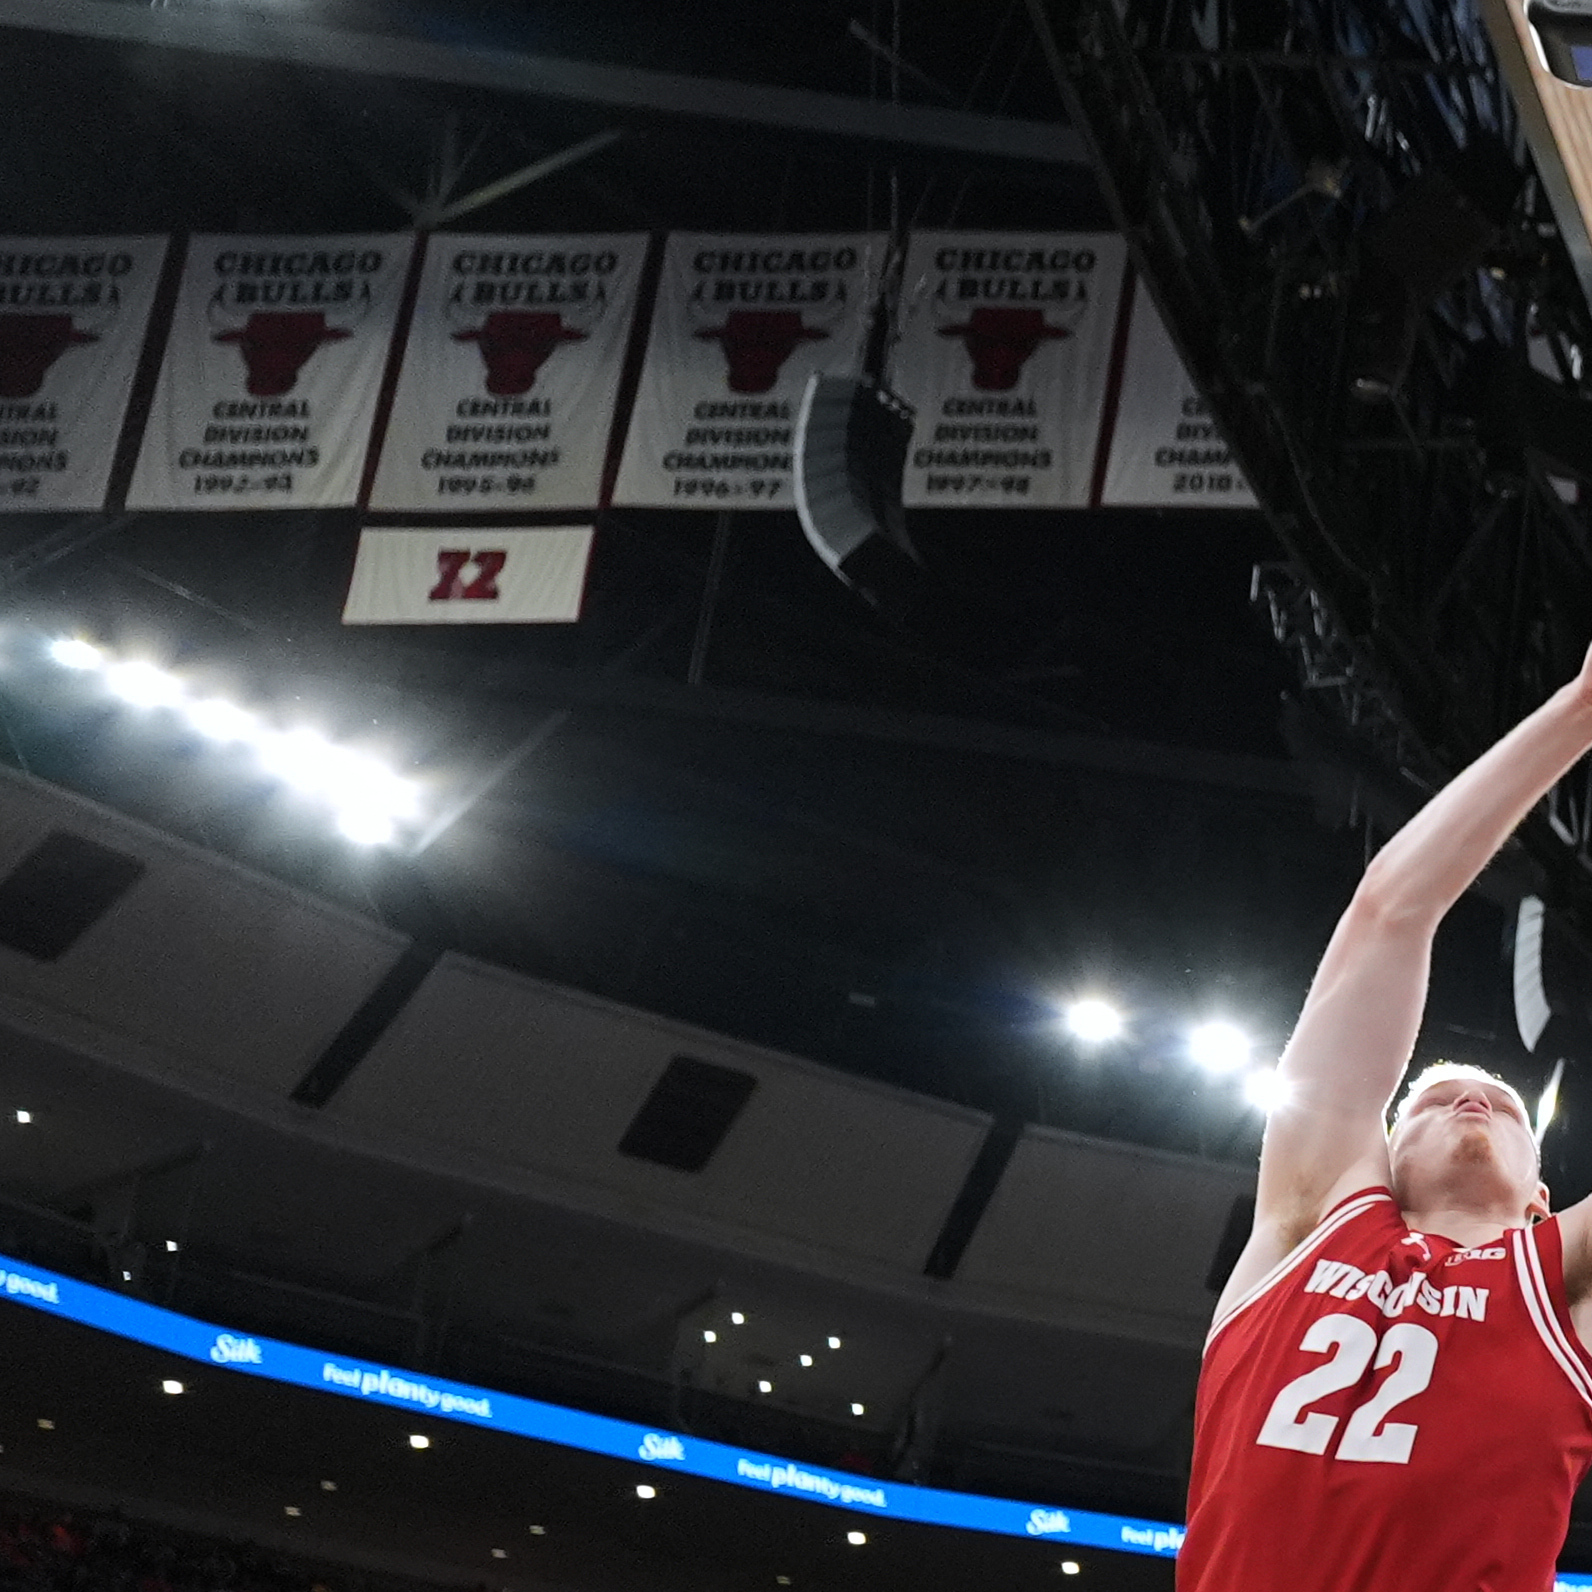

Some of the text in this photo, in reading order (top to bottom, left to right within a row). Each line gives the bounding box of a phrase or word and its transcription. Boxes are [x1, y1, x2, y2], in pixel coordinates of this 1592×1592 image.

[214, 250, 381, 276] CHICAGO
[453, 250, 617, 276] CHICAGO
[693, 249, 856, 274] CHICAGO
[935, 248, 1095, 273] CHICAGO
[1304, 1259, 1490, 1322] WISCONSIN
[210, 1332, 264, 1366] Silk
[323, 1364, 490, 1417] Feel planty good.
[1256, 1312, 1439, 1464] 22
[638, 1432, 686, 1461] Silk
[1026, 1508, 1072, 1537] Silk
